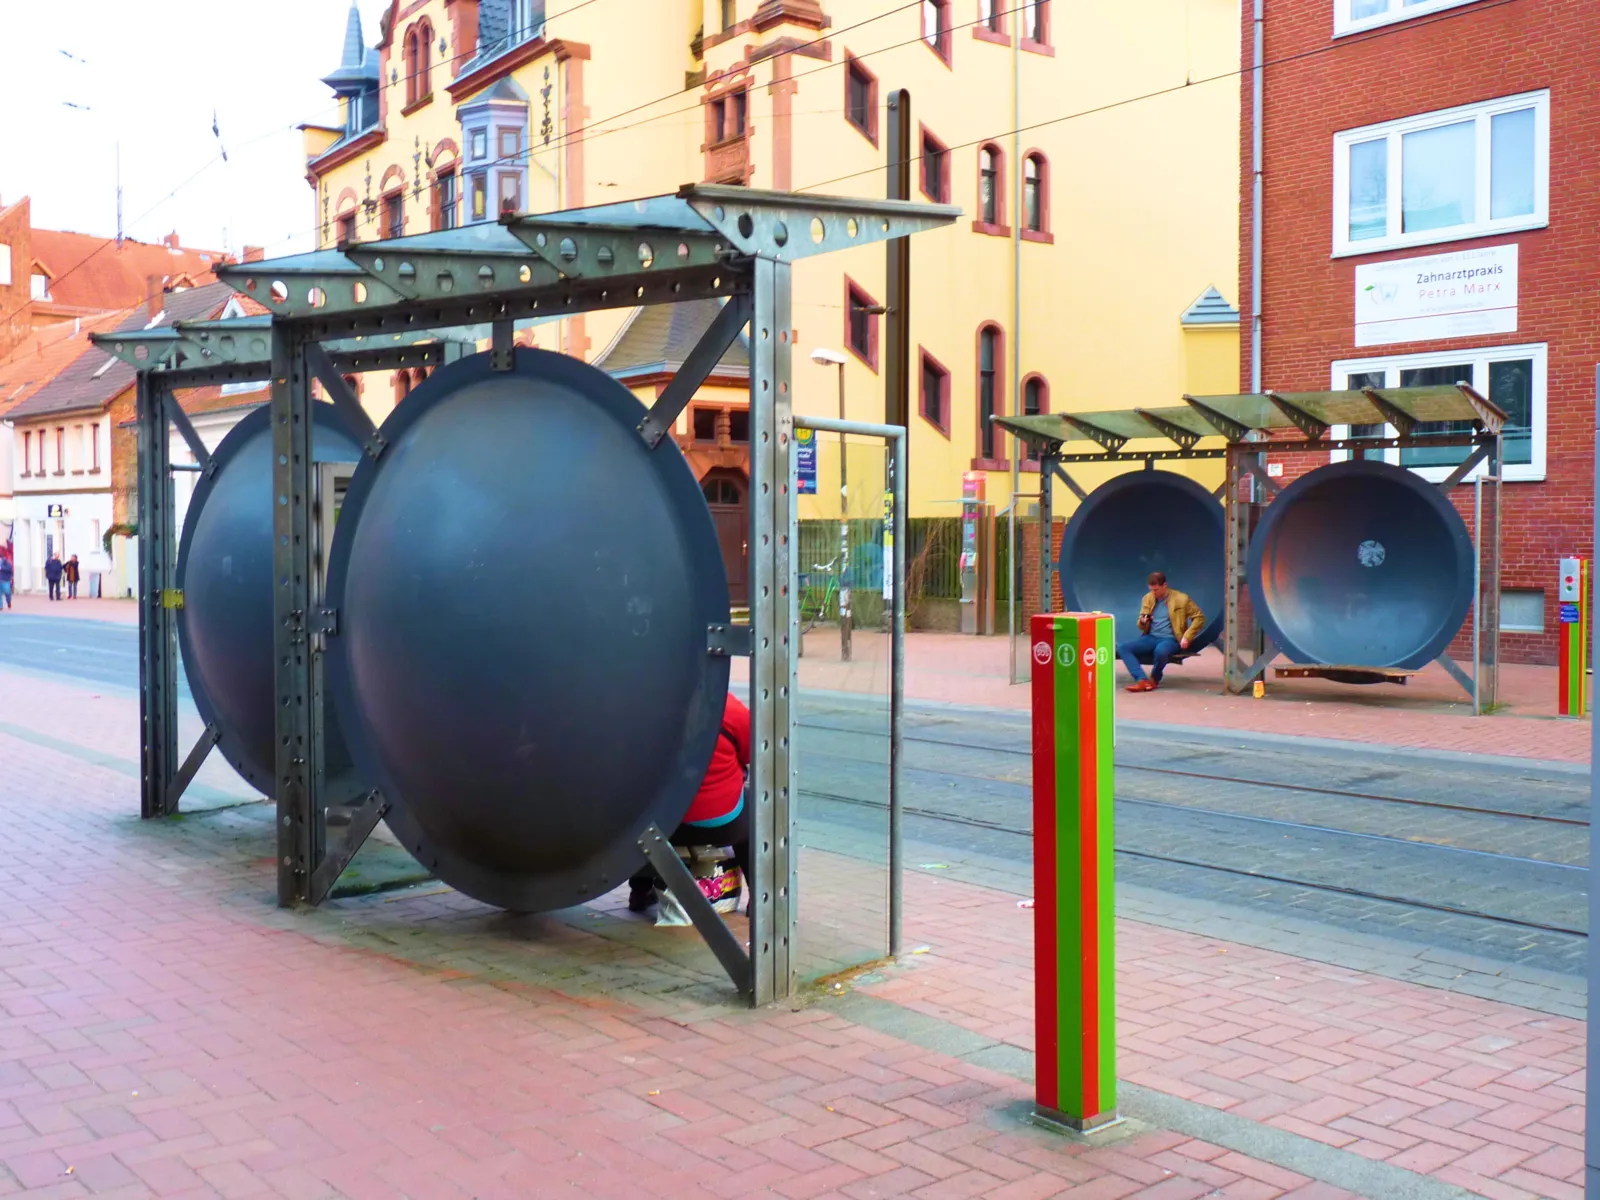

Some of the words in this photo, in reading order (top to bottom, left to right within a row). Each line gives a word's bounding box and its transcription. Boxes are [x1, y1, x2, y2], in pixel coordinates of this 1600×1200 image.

[1416, 263, 1503, 285] Zahnarztpraxis
[1419, 287, 1457, 300] Petra
[1464, 281, 1501, 295] Marx
